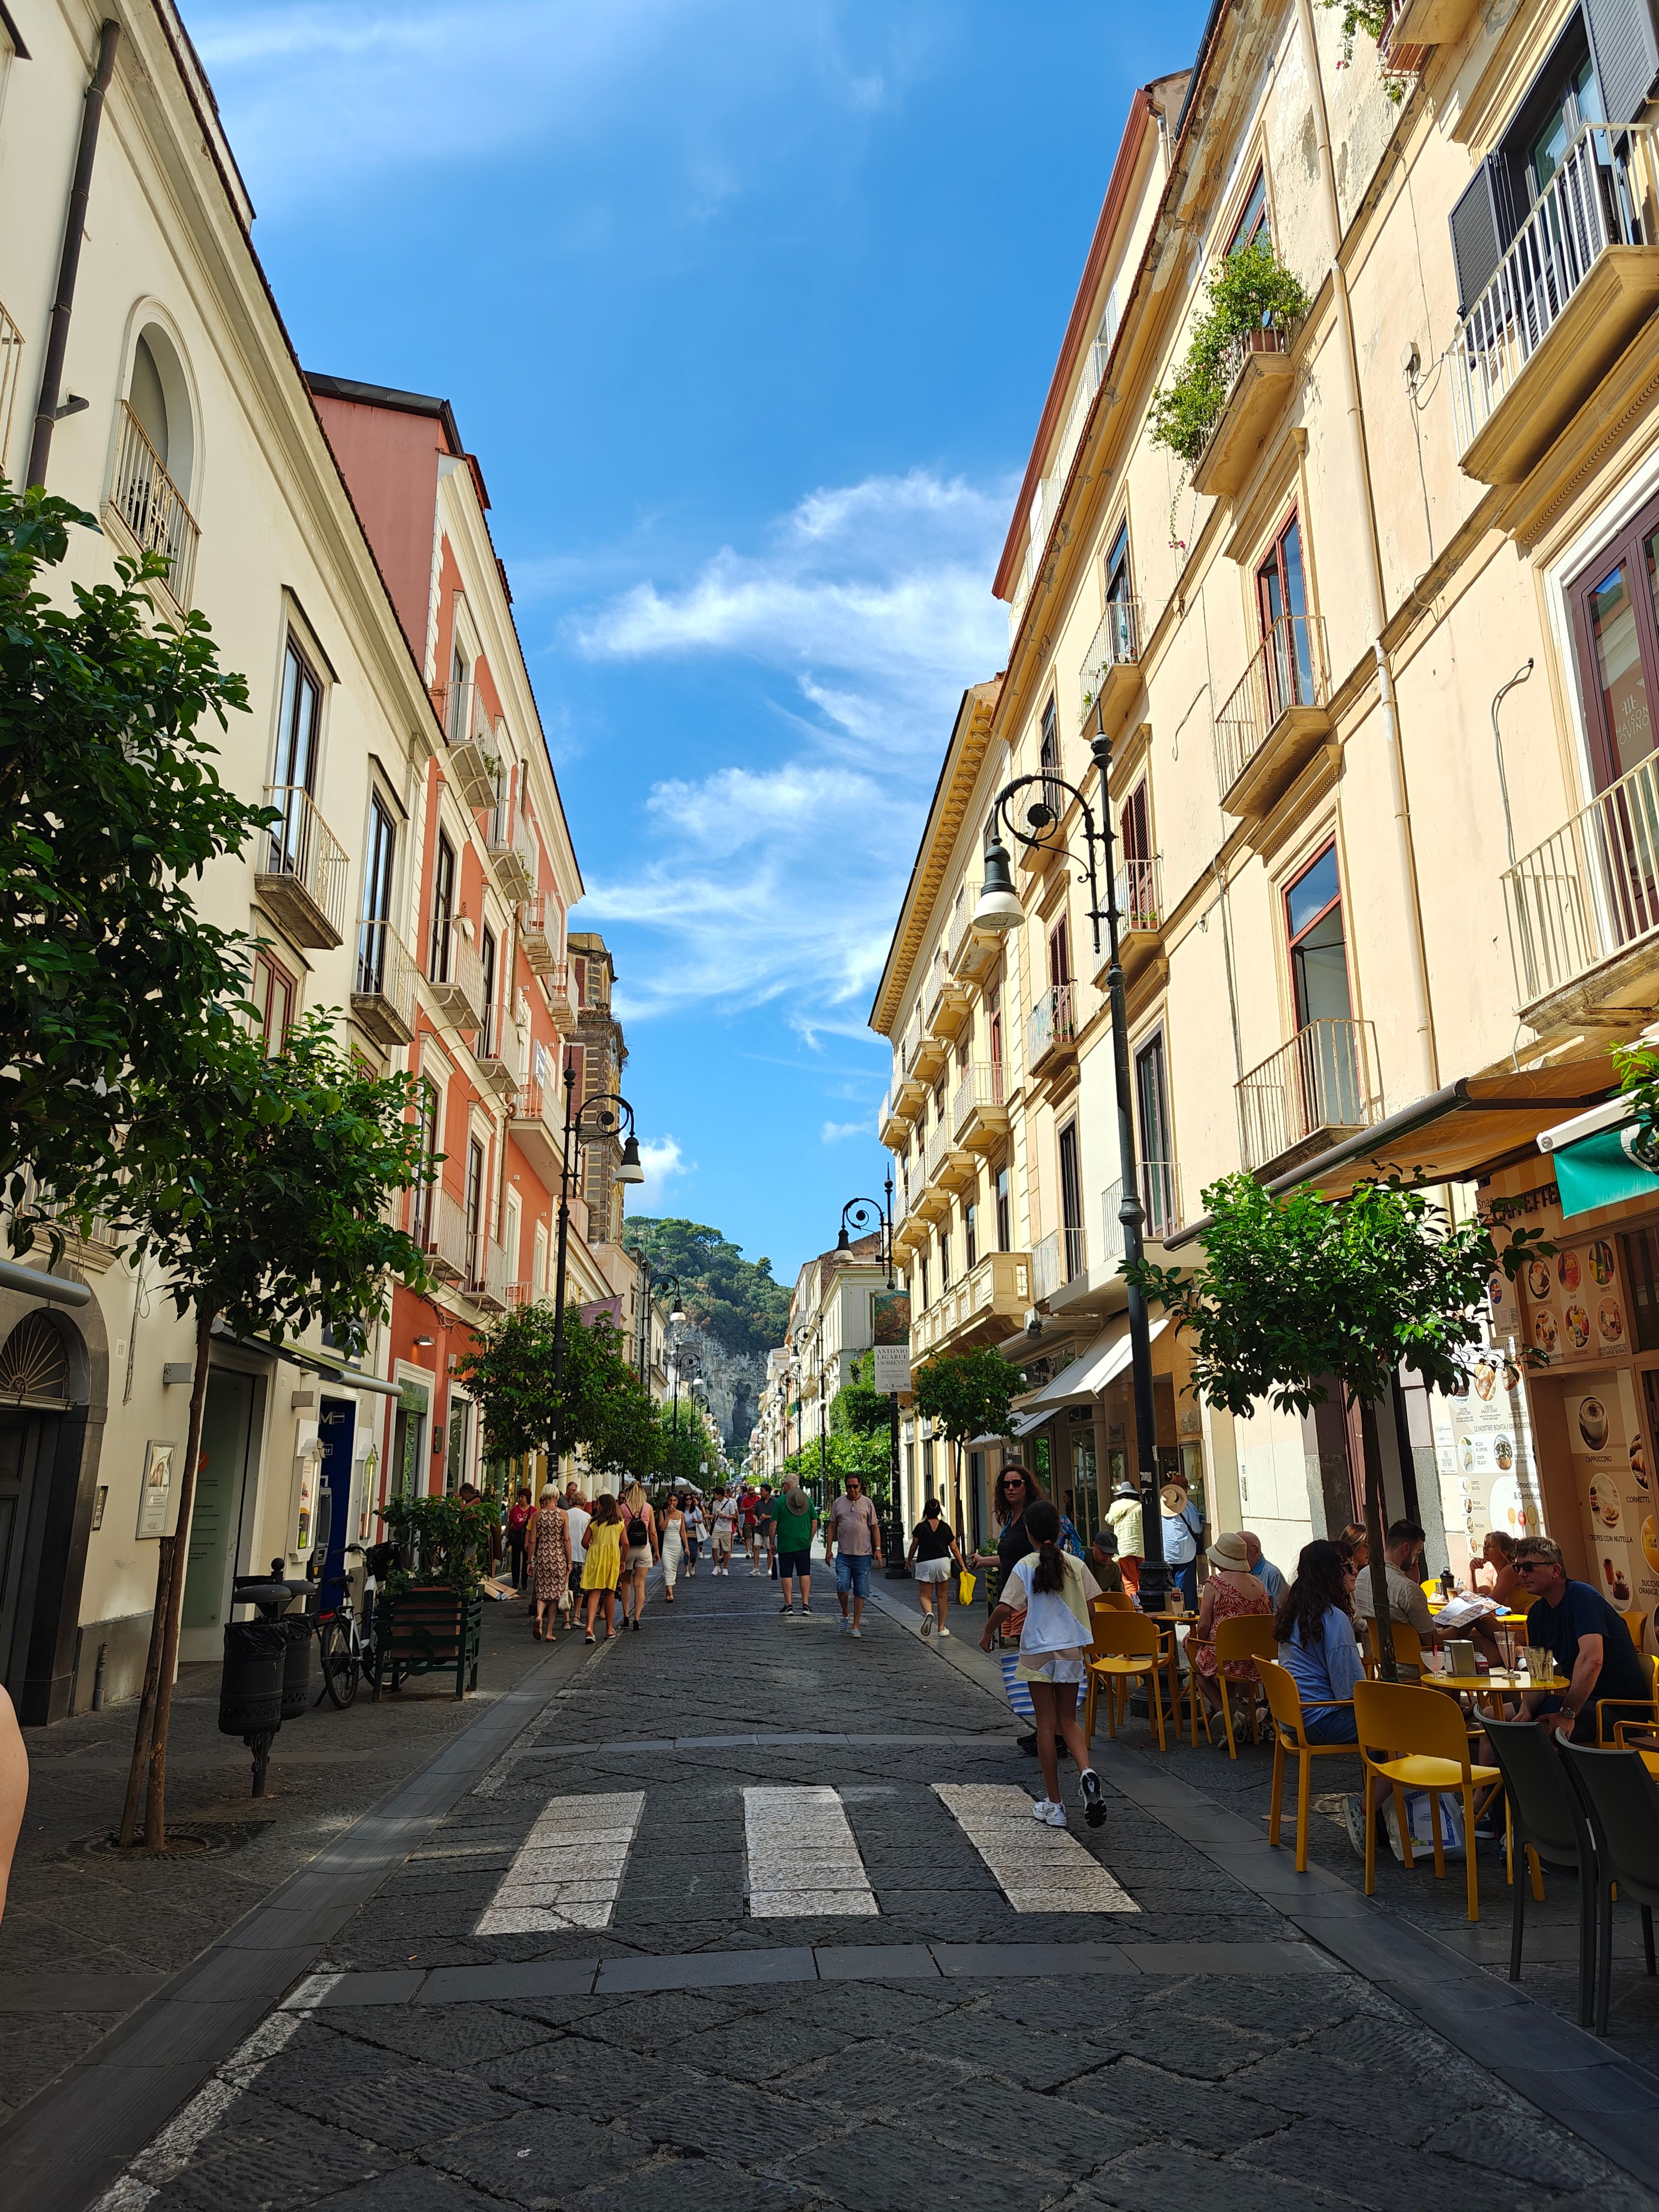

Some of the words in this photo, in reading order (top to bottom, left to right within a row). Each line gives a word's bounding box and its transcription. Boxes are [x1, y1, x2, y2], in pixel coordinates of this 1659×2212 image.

[1616, 703, 1648, 734] MAISON
[1620, 714, 1649, 745] OVINO
[1516, 1481, 1540, 1489] Smoothies
[1638, 1587, 1658, 1595] ORANGE
